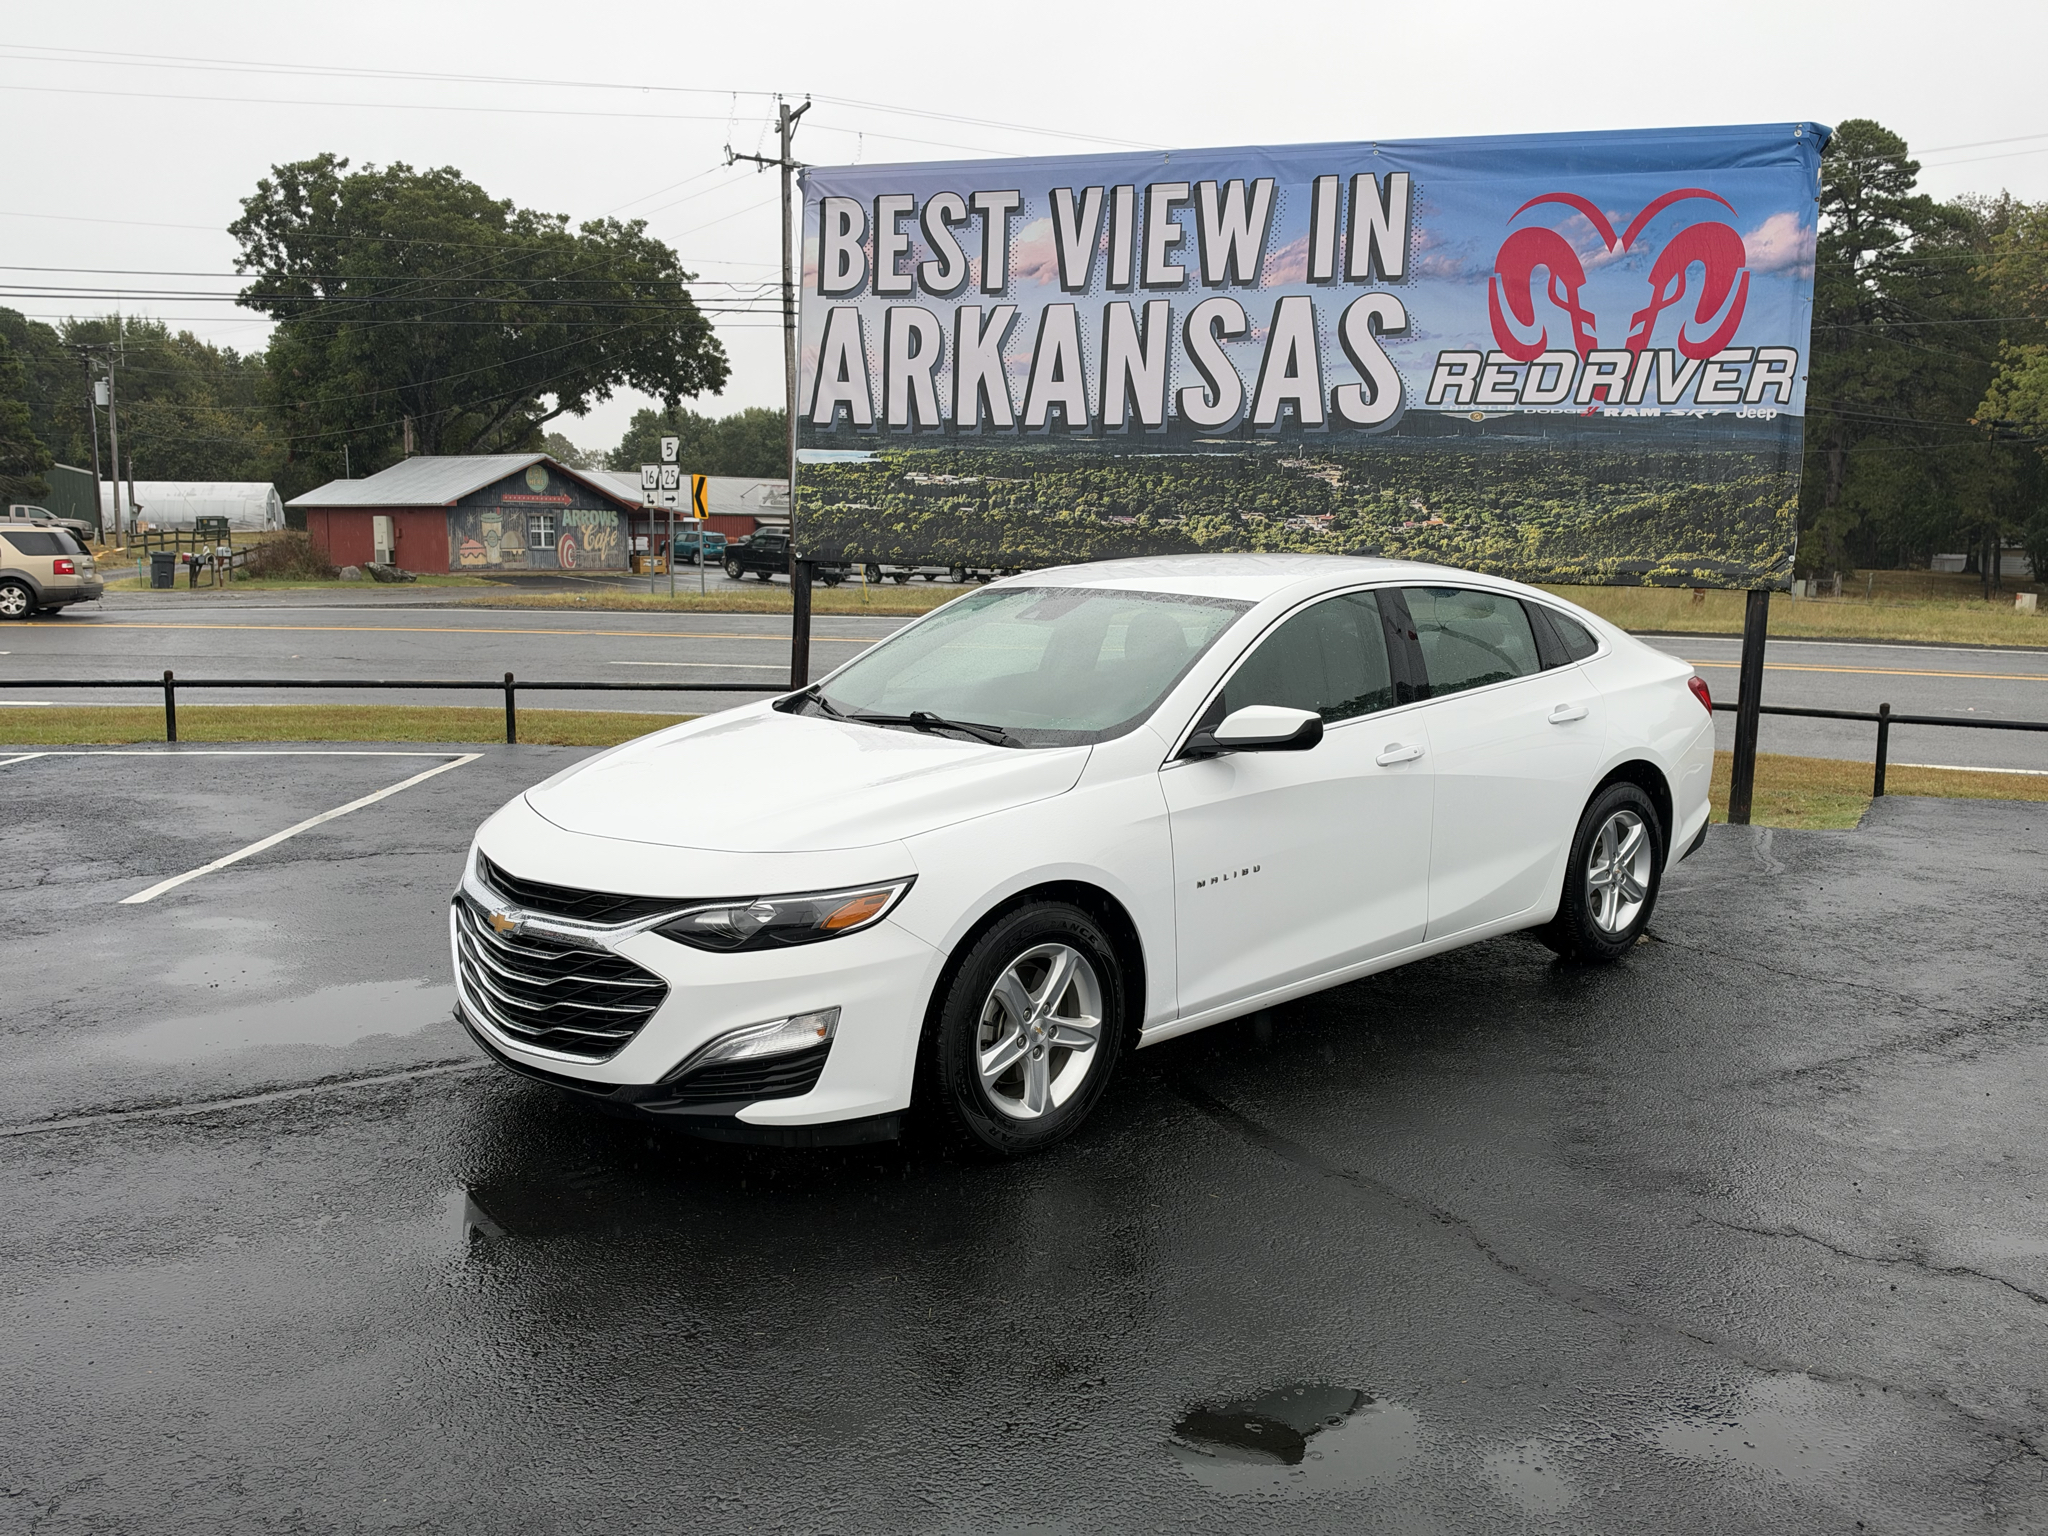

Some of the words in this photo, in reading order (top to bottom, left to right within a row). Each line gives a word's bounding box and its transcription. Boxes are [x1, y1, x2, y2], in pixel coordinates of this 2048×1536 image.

[817, 189, 1021, 297] BEST
[1049, 177, 1275, 293] VIEW
[1306, 172, 1411, 286] IN
[809, 292, 1411, 432] ARKANSAS
[1425, 346, 1798, 405] REDRIVER
[1604, 407, 1661, 417] RAM
[1665, 408, 1730, 419] SRT
[1736, 405, 1777, 421] Jeep
[666, 442, 673, 457] 5
[645, 470, 655, 485] 16
[664, 469, 676, 485] 25
[562, 509, 619, 527] ARROWS
[581, 524, 618, 560] Cafe
[1196, 864, 1261, 889] MALIBU
